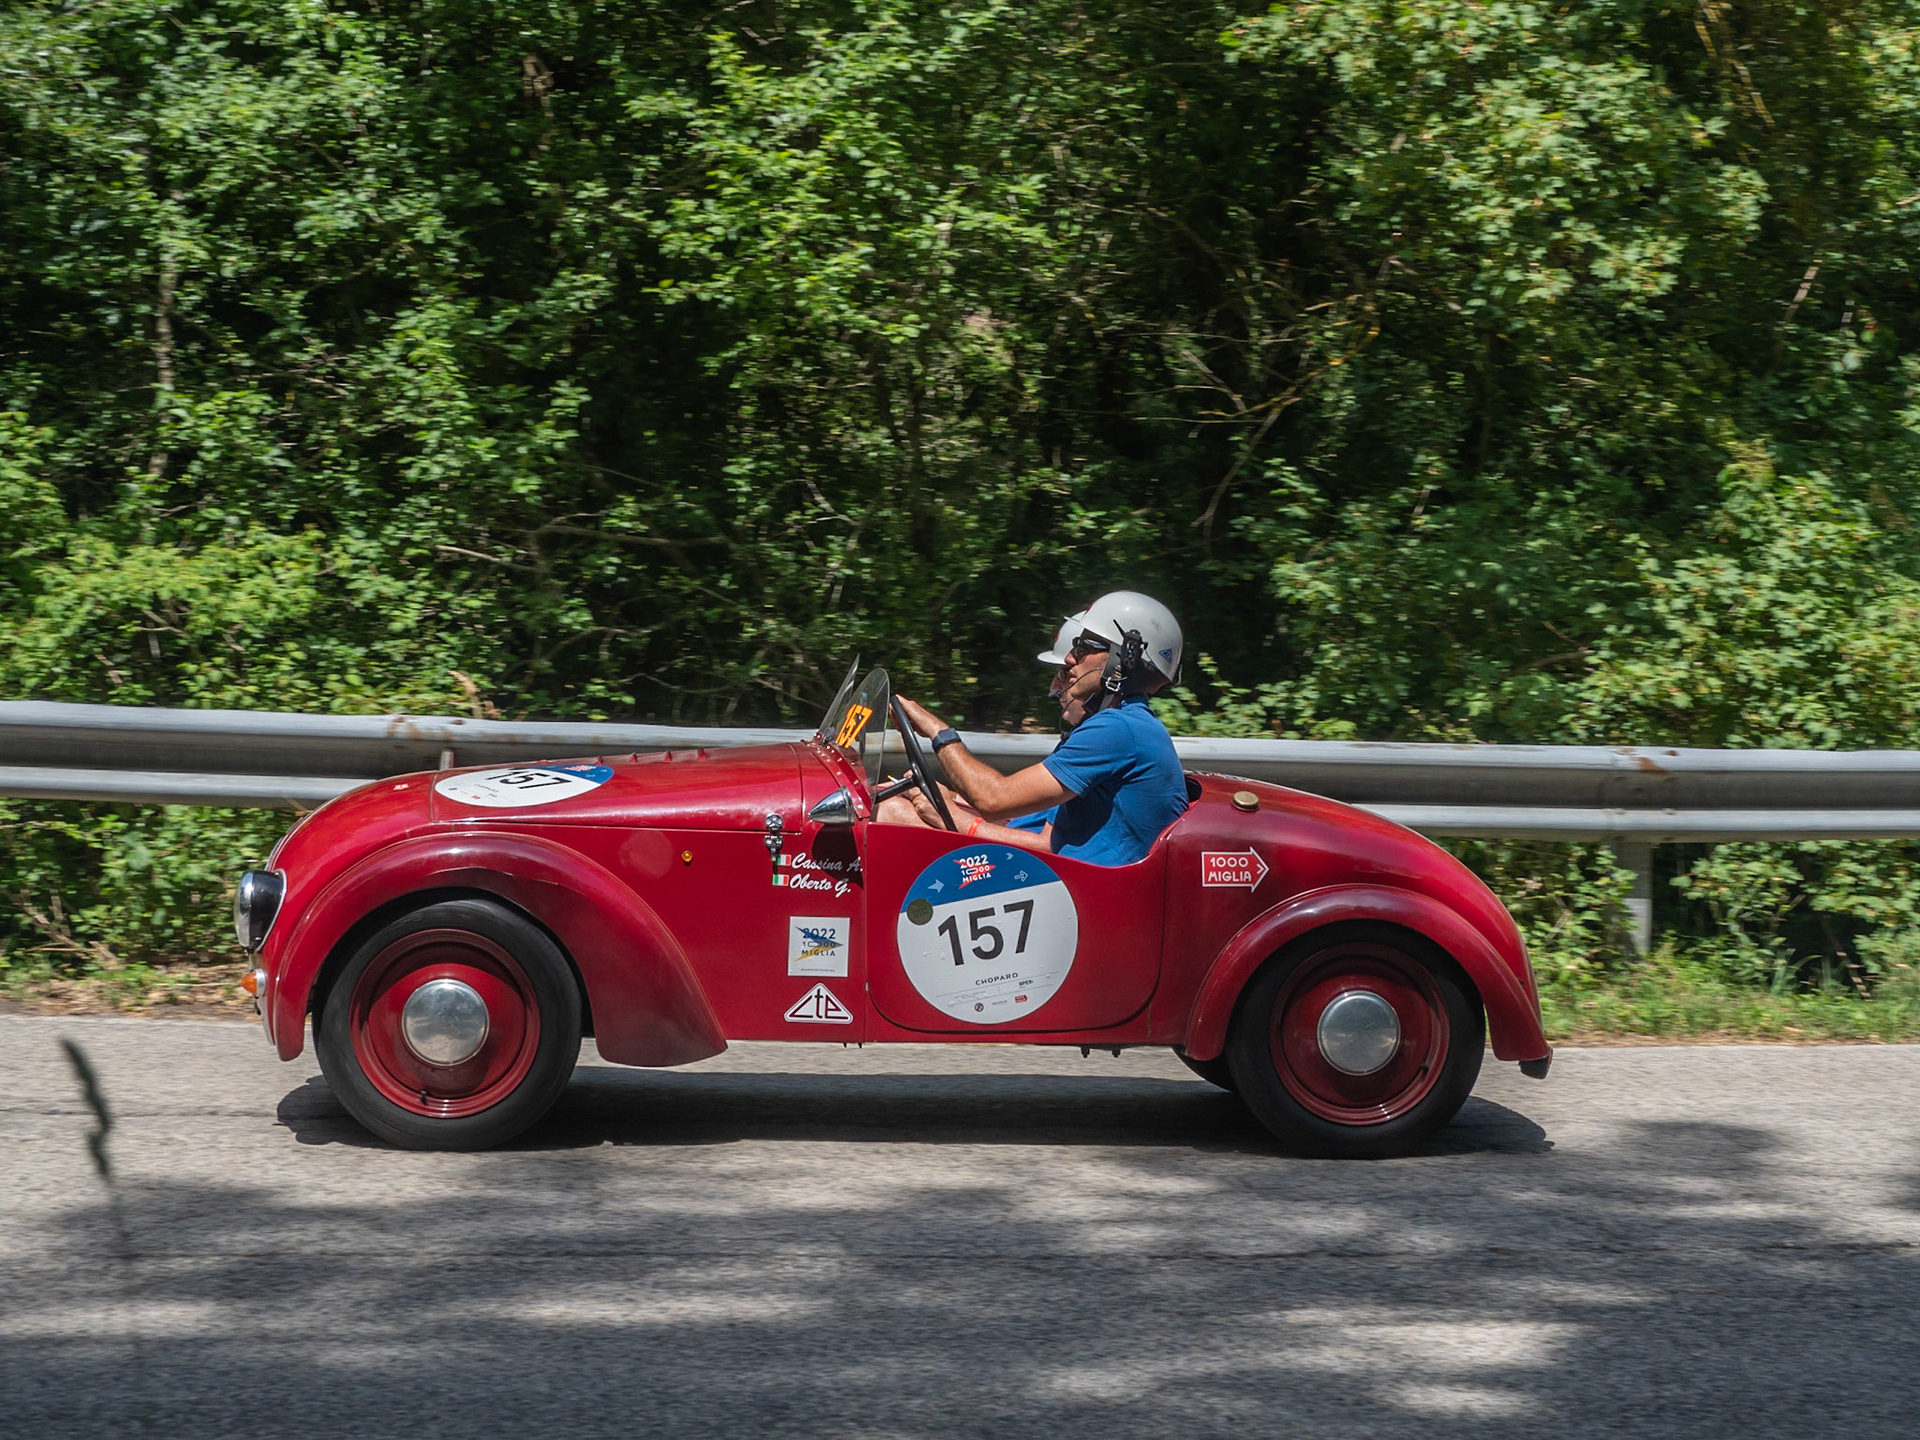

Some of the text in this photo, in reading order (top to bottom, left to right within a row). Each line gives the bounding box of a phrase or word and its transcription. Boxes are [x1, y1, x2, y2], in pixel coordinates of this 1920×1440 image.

[486, 767, 572, 790] 157
[791, 852, 843, 870] Cassina
[959, 854, 989, 869] 2022
[1210, 857, 1249, 868] 1000
[790, 873, 832, 890] Oberto
[962, 872, 992, 883] MIGLIA
[1208, 871, 1252, 882] MIGLIA
[802, 927, 836, 940] 2022
[937, 899, 1034, 967] 157
[801, 949, 836, 957] MIGLIA
[975, 972, 1019, 986] CHOPARD
